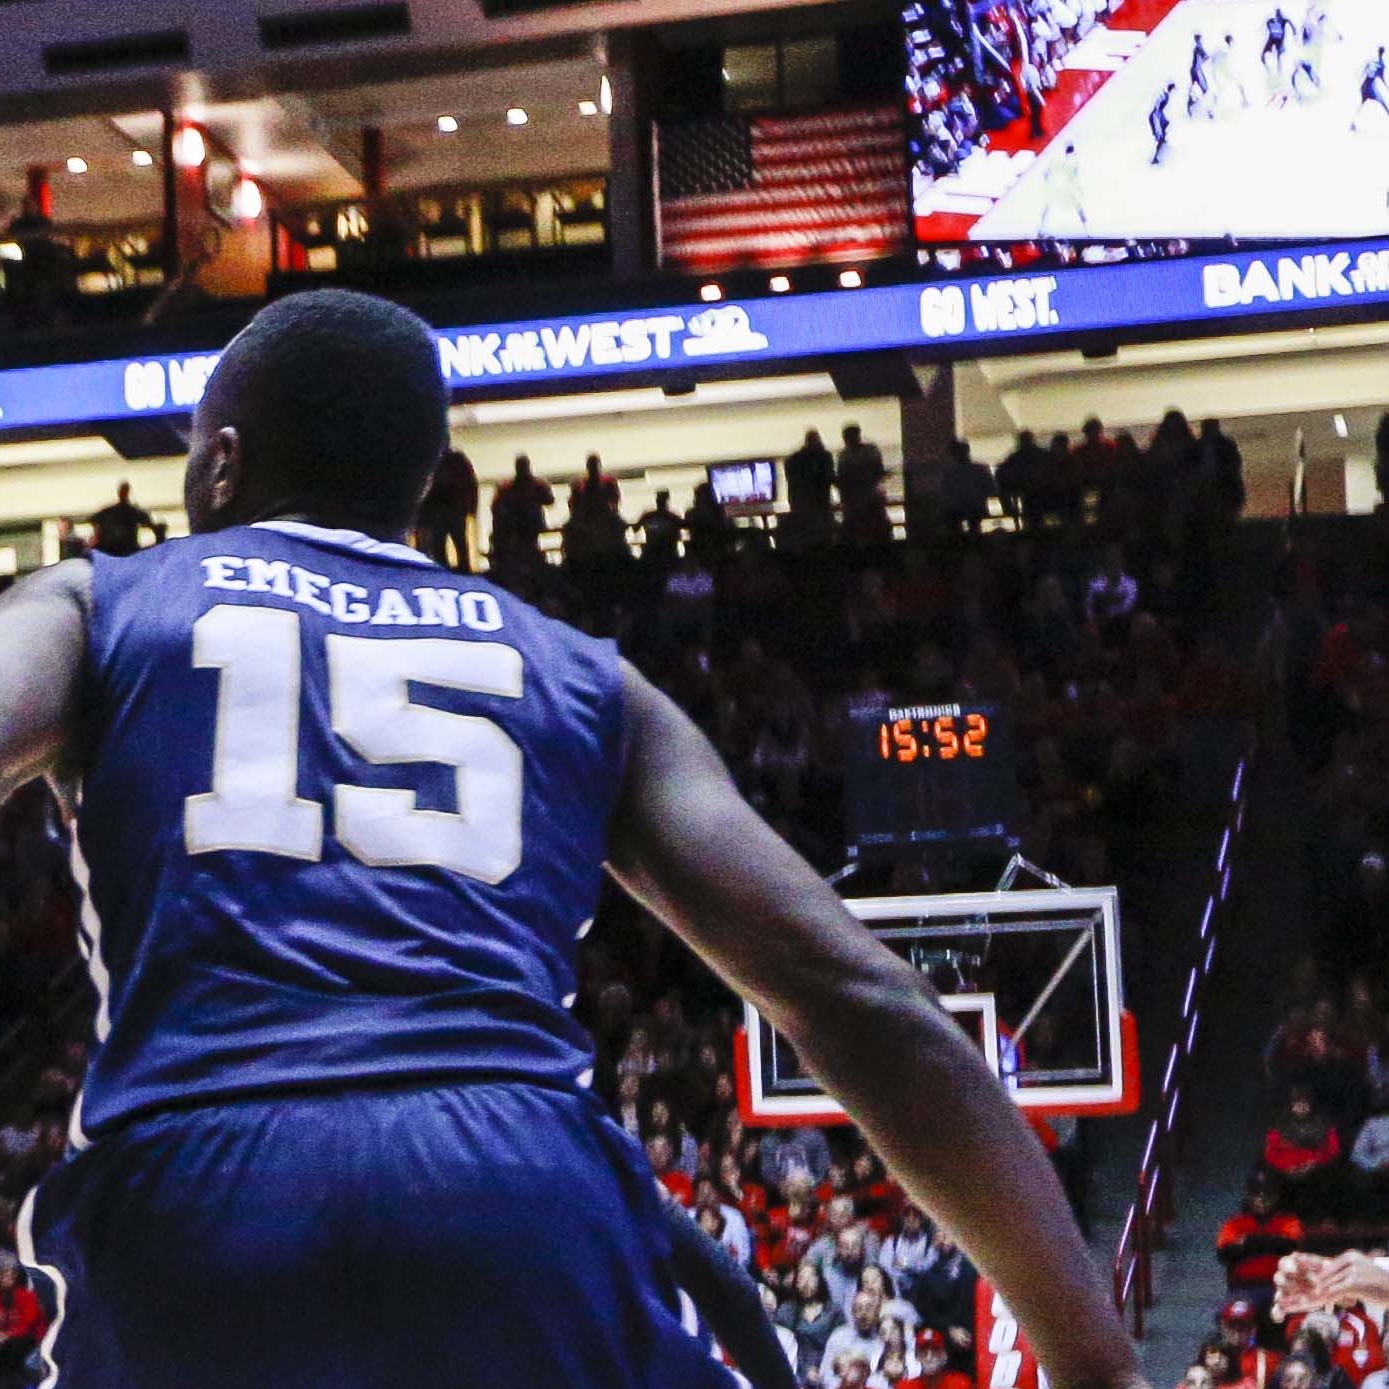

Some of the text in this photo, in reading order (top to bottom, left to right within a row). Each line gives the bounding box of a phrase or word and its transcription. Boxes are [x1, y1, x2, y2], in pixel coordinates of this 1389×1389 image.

[1203, 252, 1353, 308] BANK
[541, 315, 685, 369] WEST
[200, 554, 504, 633] EMEGANO
[183, 602, 524, 886] 15
[878, 712, 989, 764] 15:52
